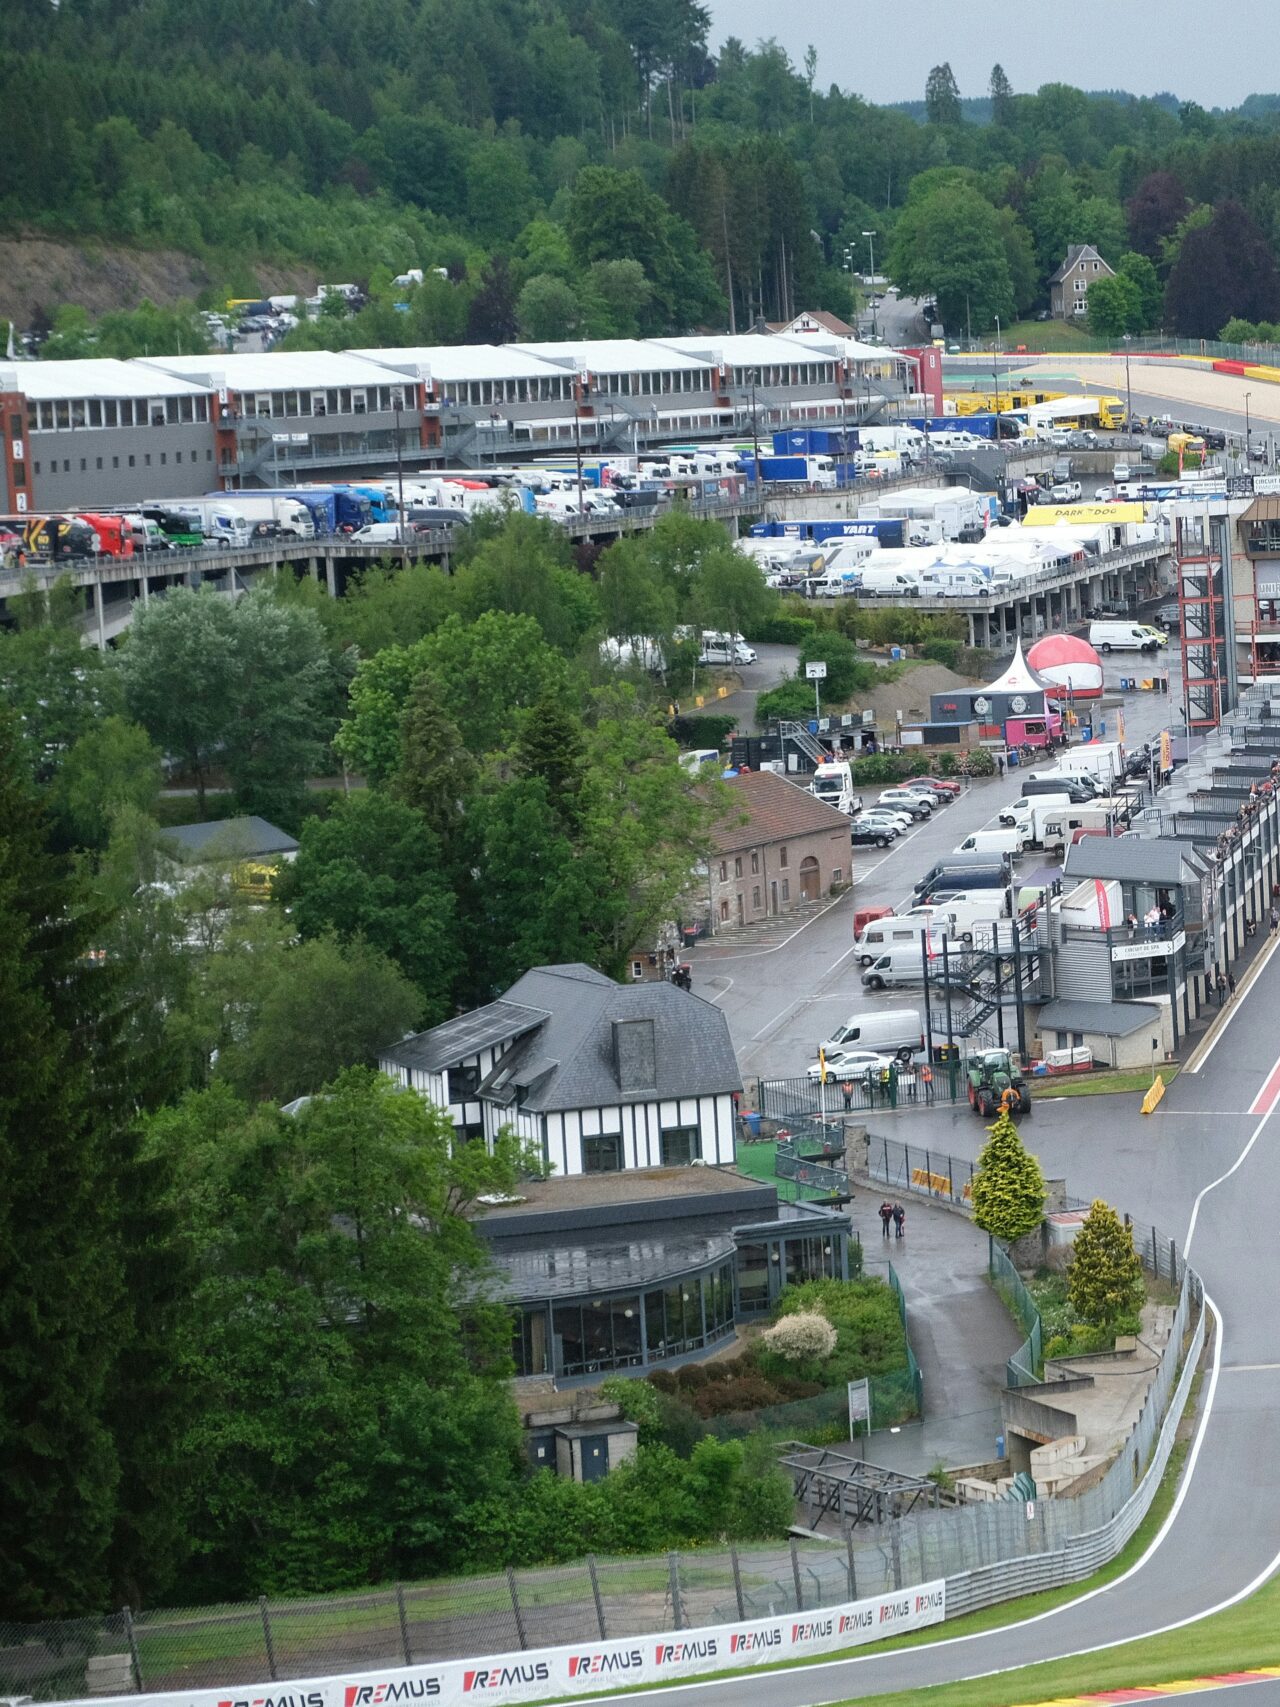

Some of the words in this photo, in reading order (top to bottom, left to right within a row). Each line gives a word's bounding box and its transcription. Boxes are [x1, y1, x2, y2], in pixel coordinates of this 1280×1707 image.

[221, 388, 226, 401] 3
[15, 442, 21, 457] 2
[19, 495, 24, 509] 2
[1094, 508, 1117, 516] DOG
[842, 525, 876, 534] YART
[884, 1600, 910, 1621] REMUS
[919, 1591, 943, 1611] REMUS
[797, 1619, 833, 1641] REMUS
[844, 1610, 873, 1631] REMUS
[736, 1628, 782, 1652] REMUS
[662, 1639, 718, 1663] REMUS
[577, 1650, 643, 1675] REMUS
[473, 1662, 549, 1690] REMUS
[354, 1677, 441, 1705] REMUS
